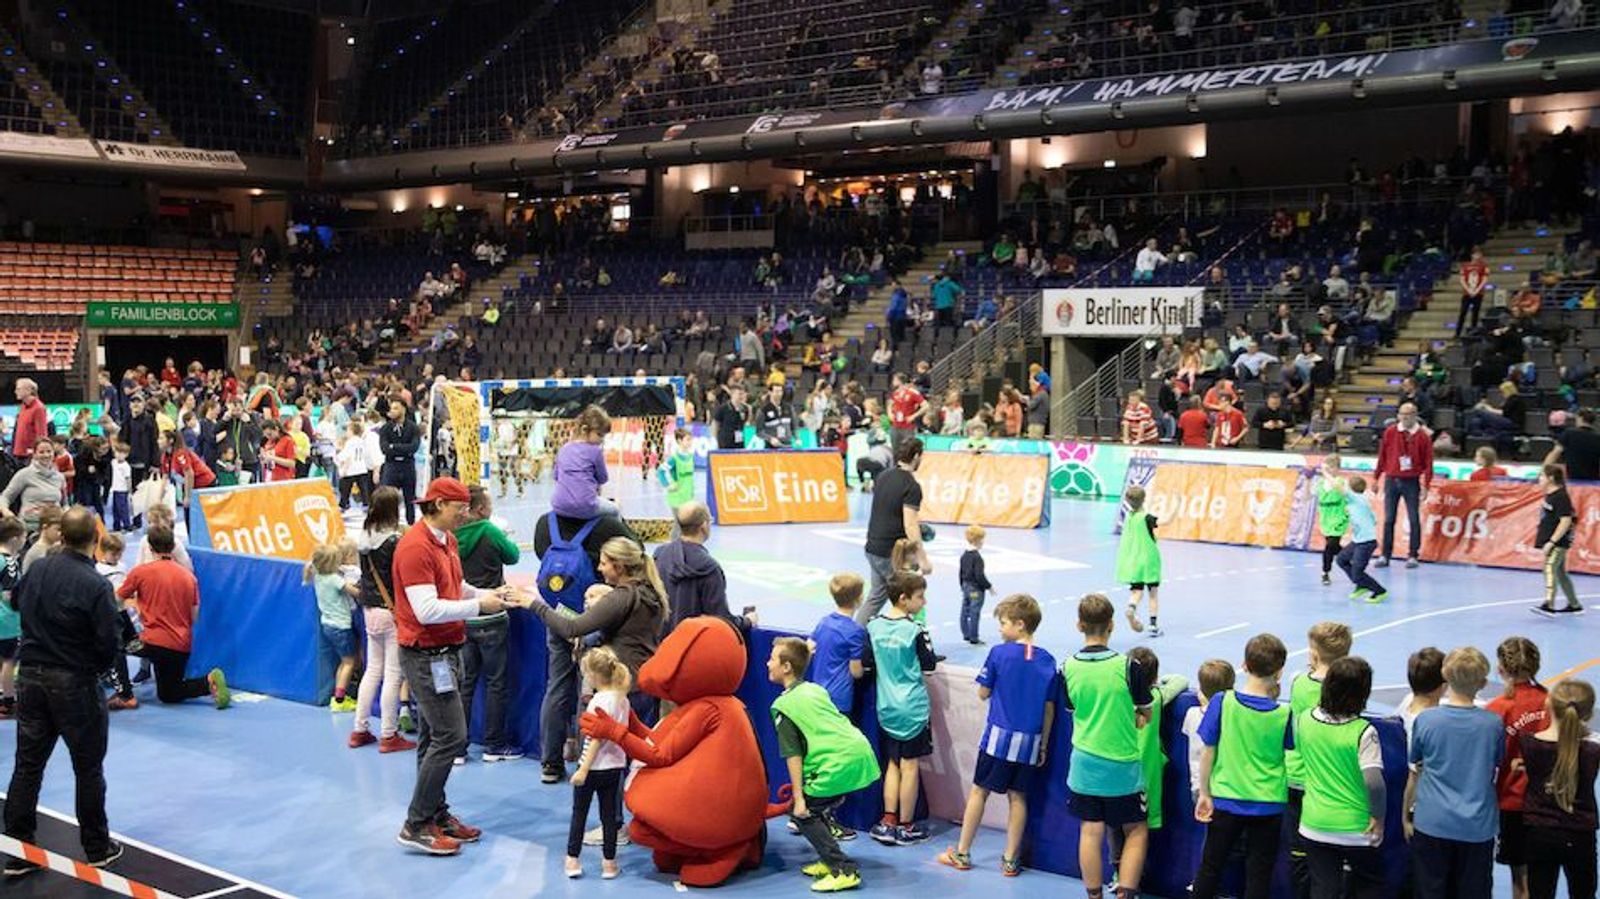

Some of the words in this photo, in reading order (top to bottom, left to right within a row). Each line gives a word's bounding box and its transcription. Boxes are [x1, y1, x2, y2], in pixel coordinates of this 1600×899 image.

[983, 81, 1082, 112] BAM!
[1093, 53, 1388, 102] HAMMERTEAM!
[110, 306, 217, 321] FAMILIENBLOCK
[1086, 297, 1146, 325] Berliner
[1150, 297, 1194, 325] Kindl
[724, 475, 761, 503] BSR
[773, 471, 838, 503] Eine
[920, 473, 1010, 505] tarke
[1023, 475, 1043, 508] B
[213, 514, 295, 555] ande
